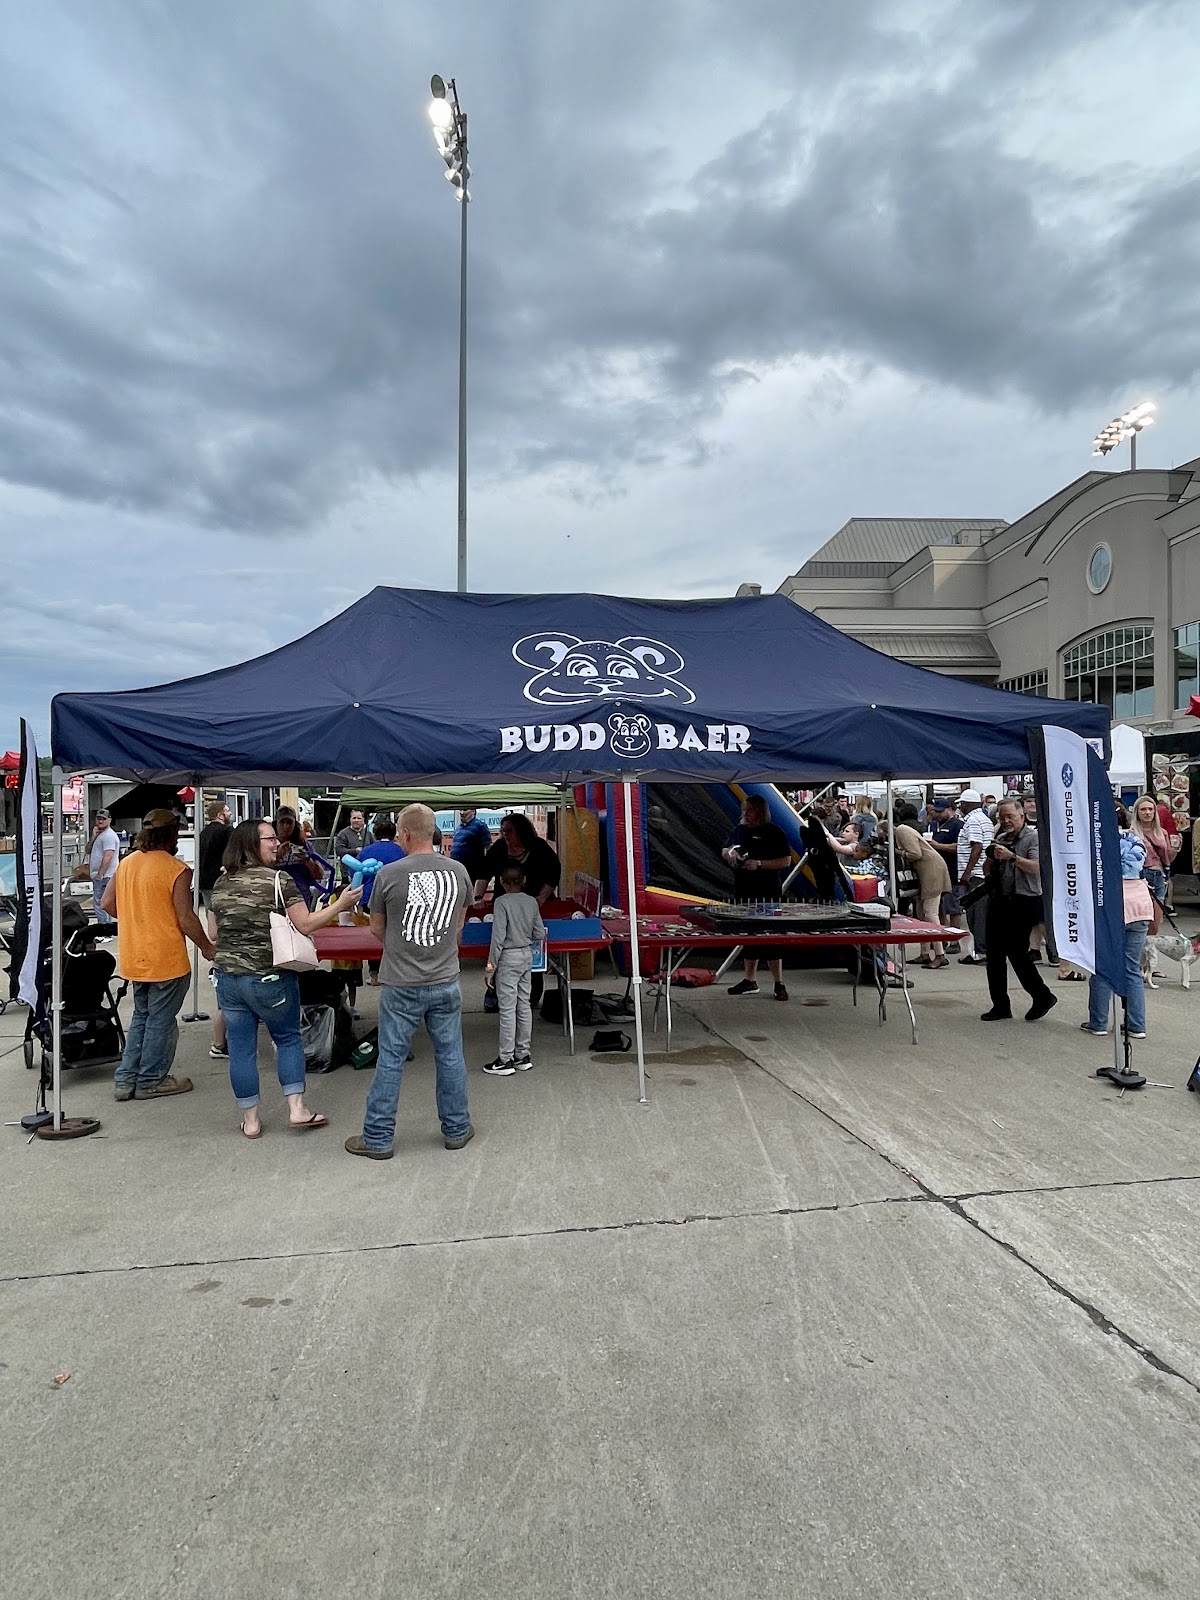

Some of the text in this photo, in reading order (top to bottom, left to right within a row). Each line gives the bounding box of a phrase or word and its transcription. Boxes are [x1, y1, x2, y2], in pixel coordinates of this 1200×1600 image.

[500, 723, 752, 753] BUDD BAER
[1064, 791, 1079, 943] SUBARU BUDD BAER
[1093, 801, 1104, 907] www.BuddBaerSubaru.com
